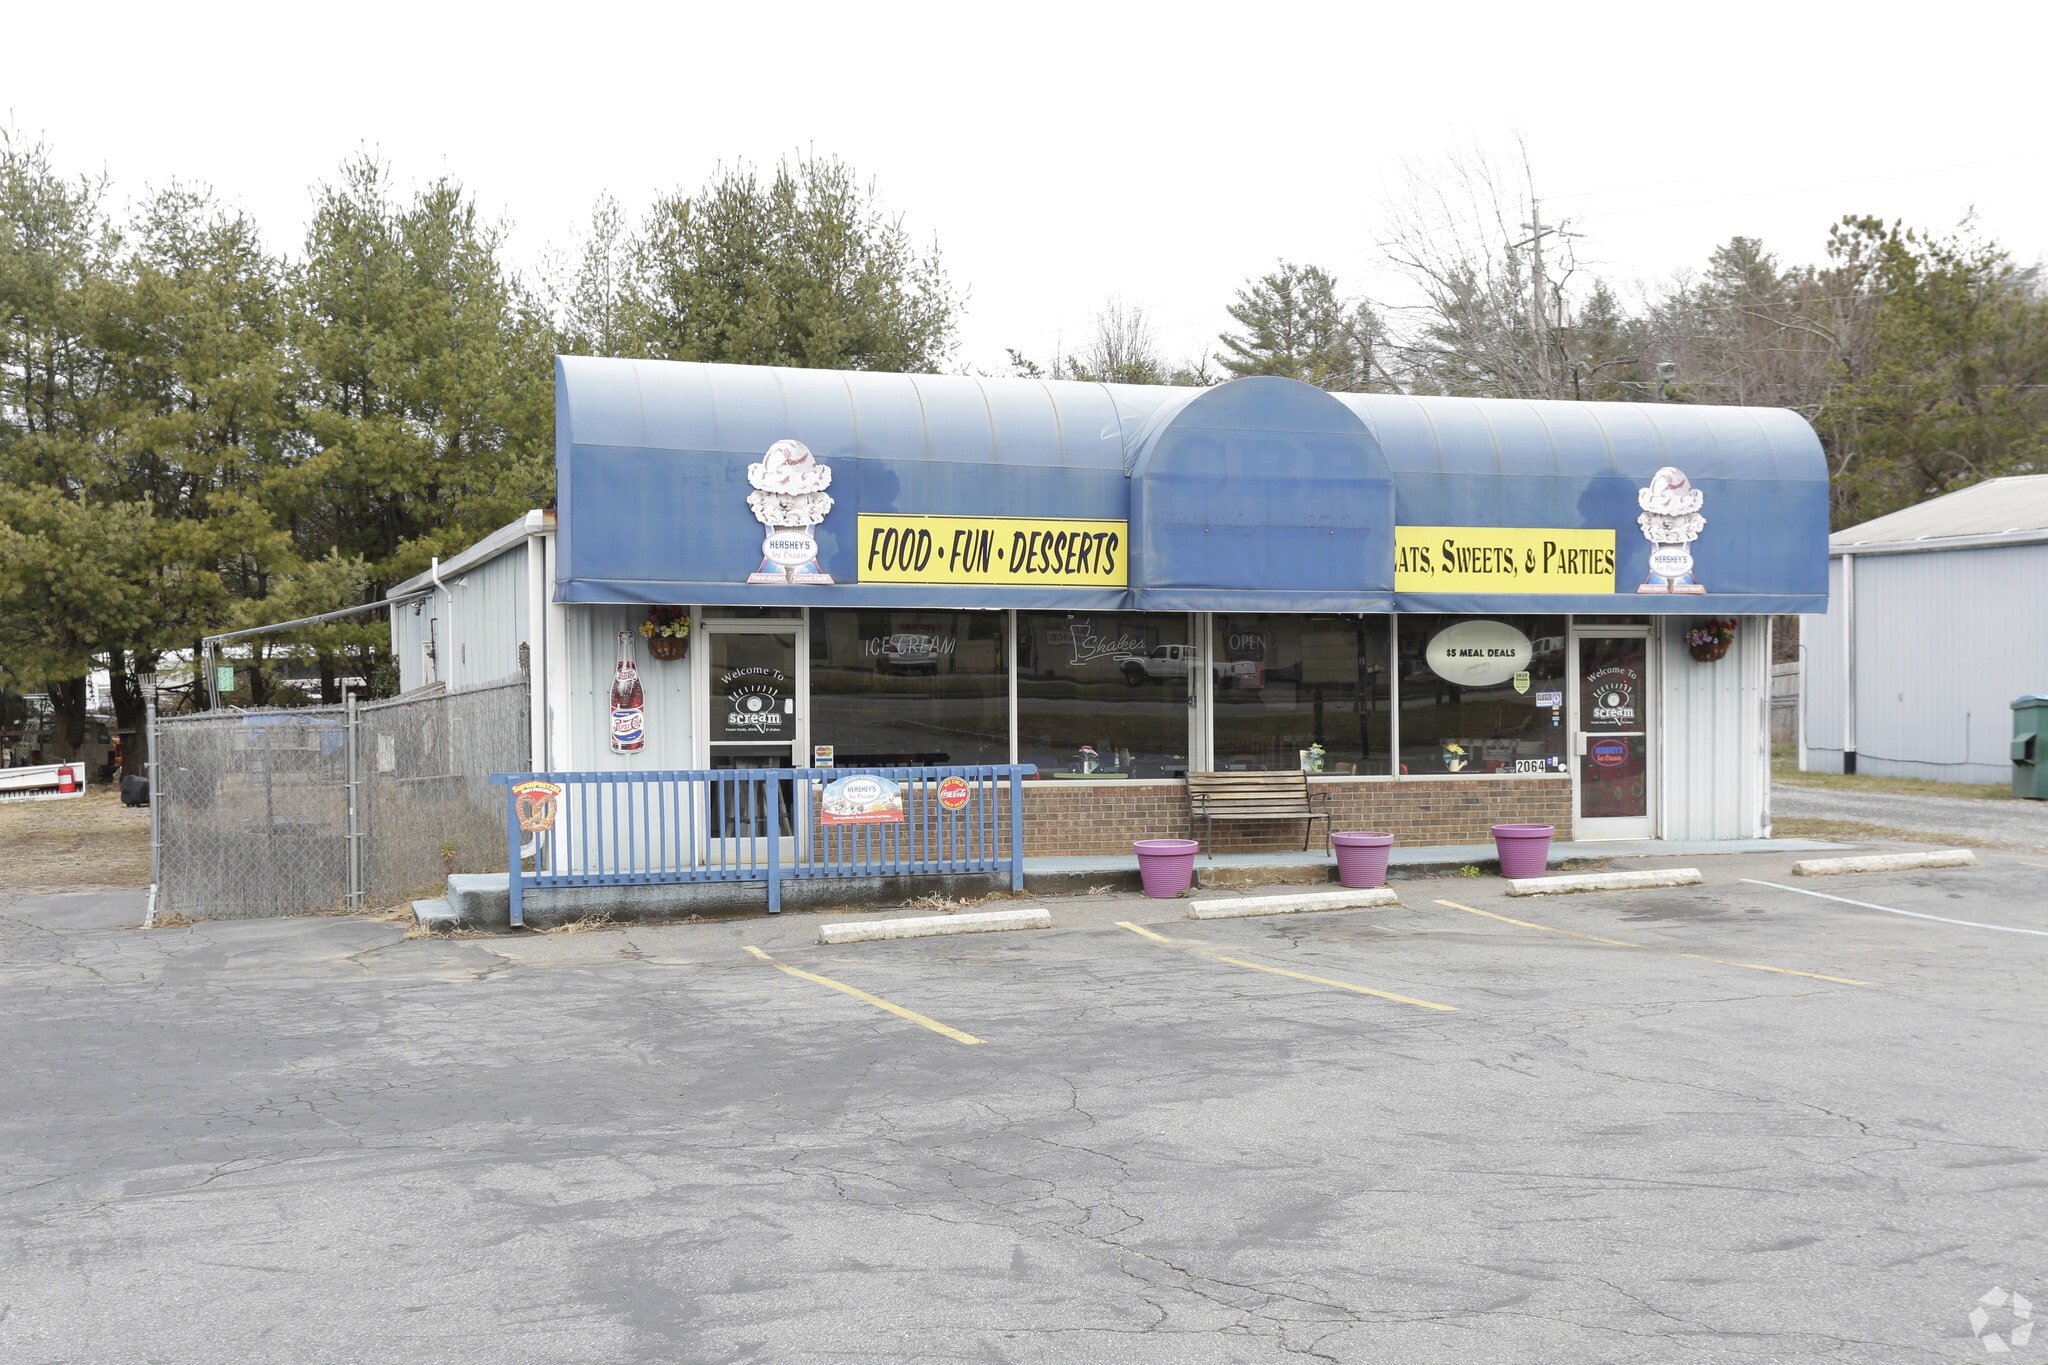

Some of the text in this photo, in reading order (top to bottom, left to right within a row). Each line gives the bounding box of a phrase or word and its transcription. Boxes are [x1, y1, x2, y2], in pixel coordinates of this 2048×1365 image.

[769, 540, 810, 550] HERSHEY'S
[868, 527, 1119, 575] FOOD FUN DESSERTS
[772, 550, 808, 559] Ice Cream
[1395, 538, 1435, 578] ATS,
[1525, 548, 1536, 574] &
[1543, 540, 1615, 575] PARTIES
[1654, 556, 1687, 564] HERSHEY'S
[865, 635, 956, 657] ICE CREAM
[1078, 633, 1145, 658] Shakes
[1230, 633, 1266, 650] OPEN
[1446, 648, 1516, 658] $5 MEAL DEALS
[720, 667, 784, 684] Welcome To
[1586, 667, 1637, 682] Welcome To
[728, 712, 781, 725] scream
[1593, 706, 1634, 718] scream
[1517, 760, 1544, 773] 2064
